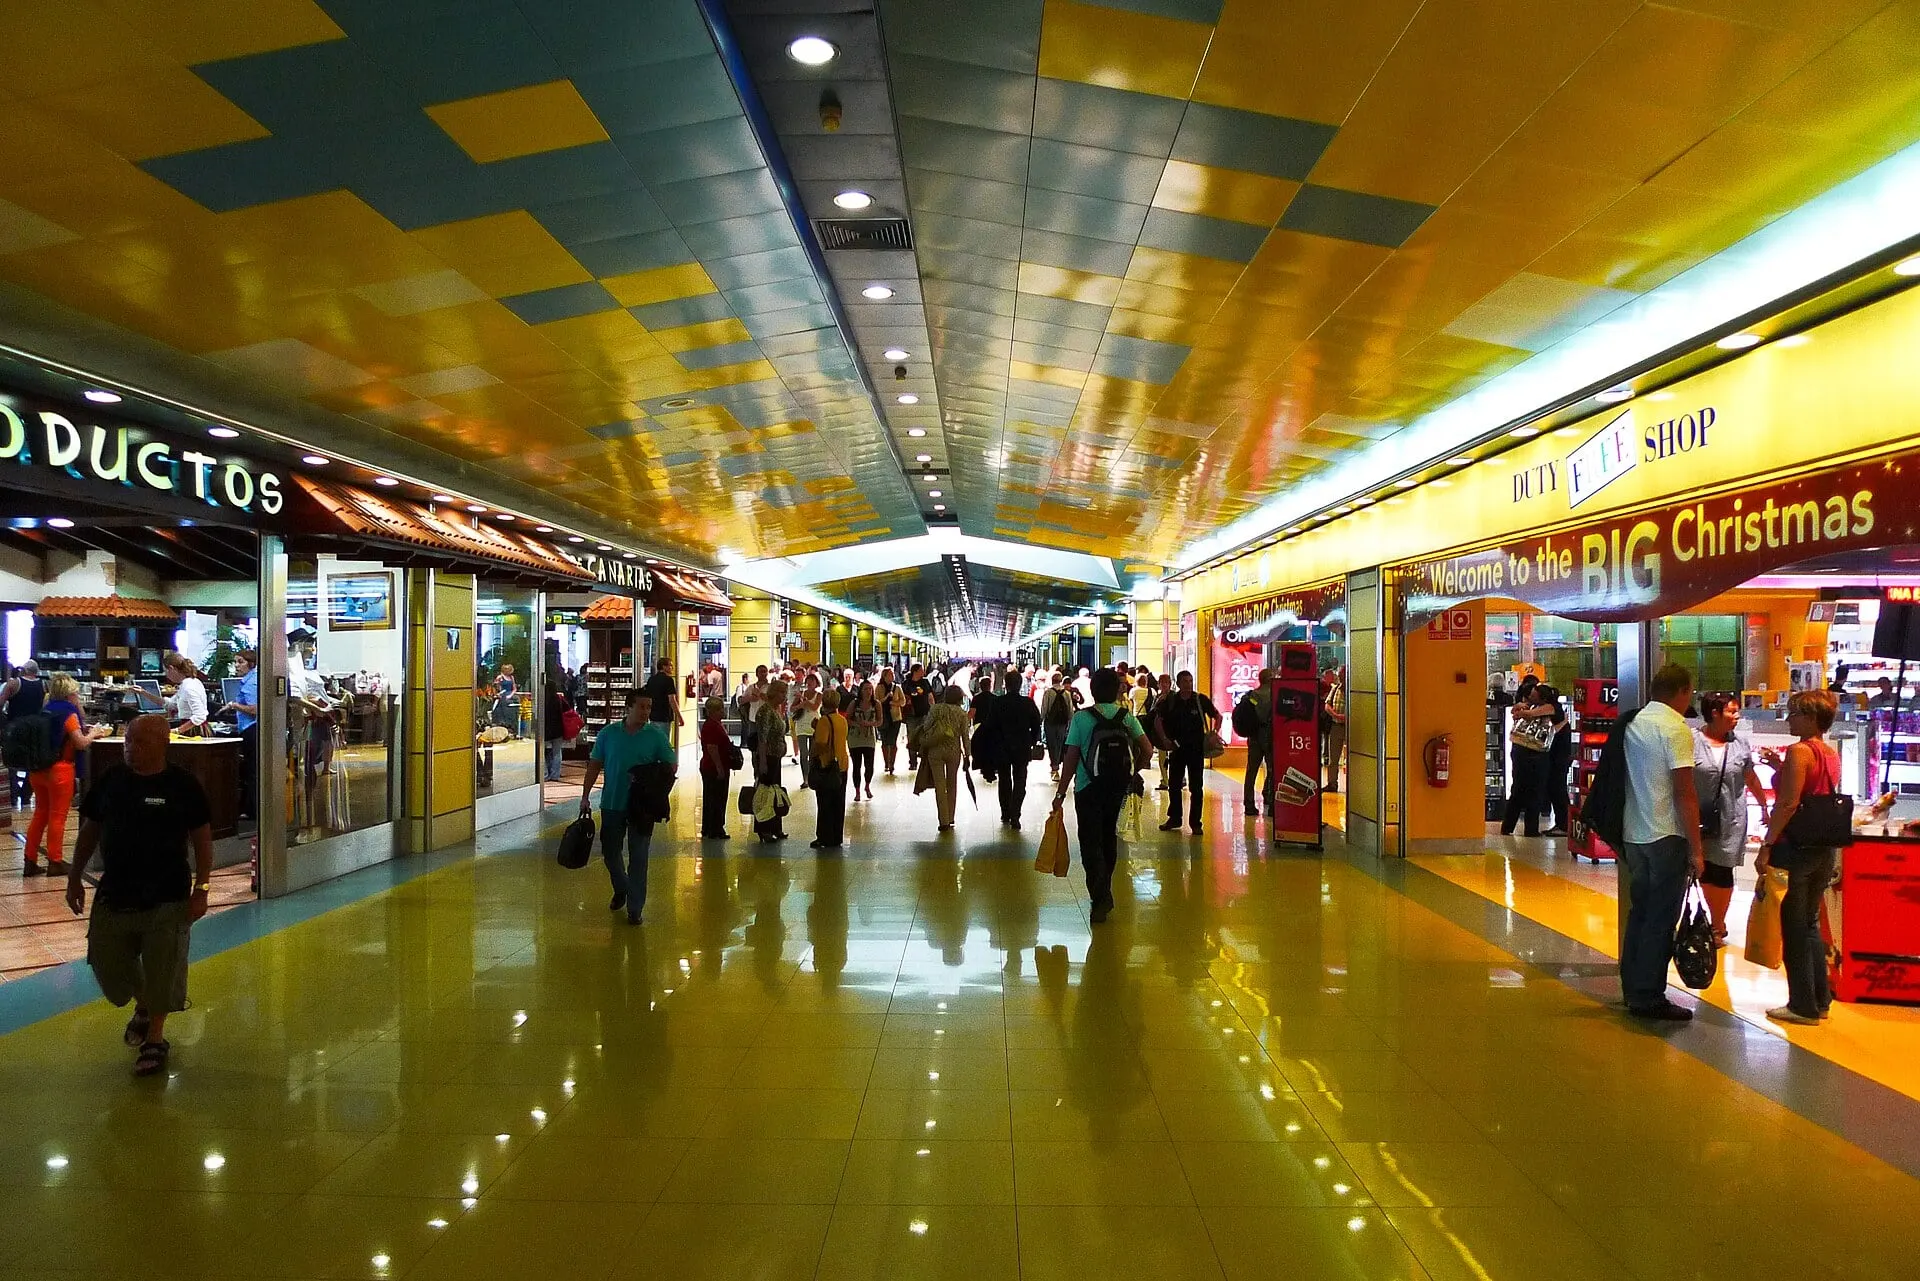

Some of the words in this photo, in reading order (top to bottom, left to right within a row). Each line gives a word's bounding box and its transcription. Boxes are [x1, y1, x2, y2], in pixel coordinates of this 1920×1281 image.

[1513, 459, 1559, 503] DUTY
[1644, 407, 1716, 463] SHOP
[1430, 560, 1504, 596] Welcome
[1509, 552, 1530, 586] to
[1536, 538, 1573, 582] the
[1583, 520, 1662, 606] BIG
[1671, 490, 1875, 562] Christmas
[587, 556, 653, 591] CANARIAS
[1216, 607, 1236, 628] Welcome
[1237, 608, 1243, 625] to
[1244, 603, 1253, 624] the
[1270, 597, 1303, 618] Christmas
[1289, 736, 1304, 750] 13
